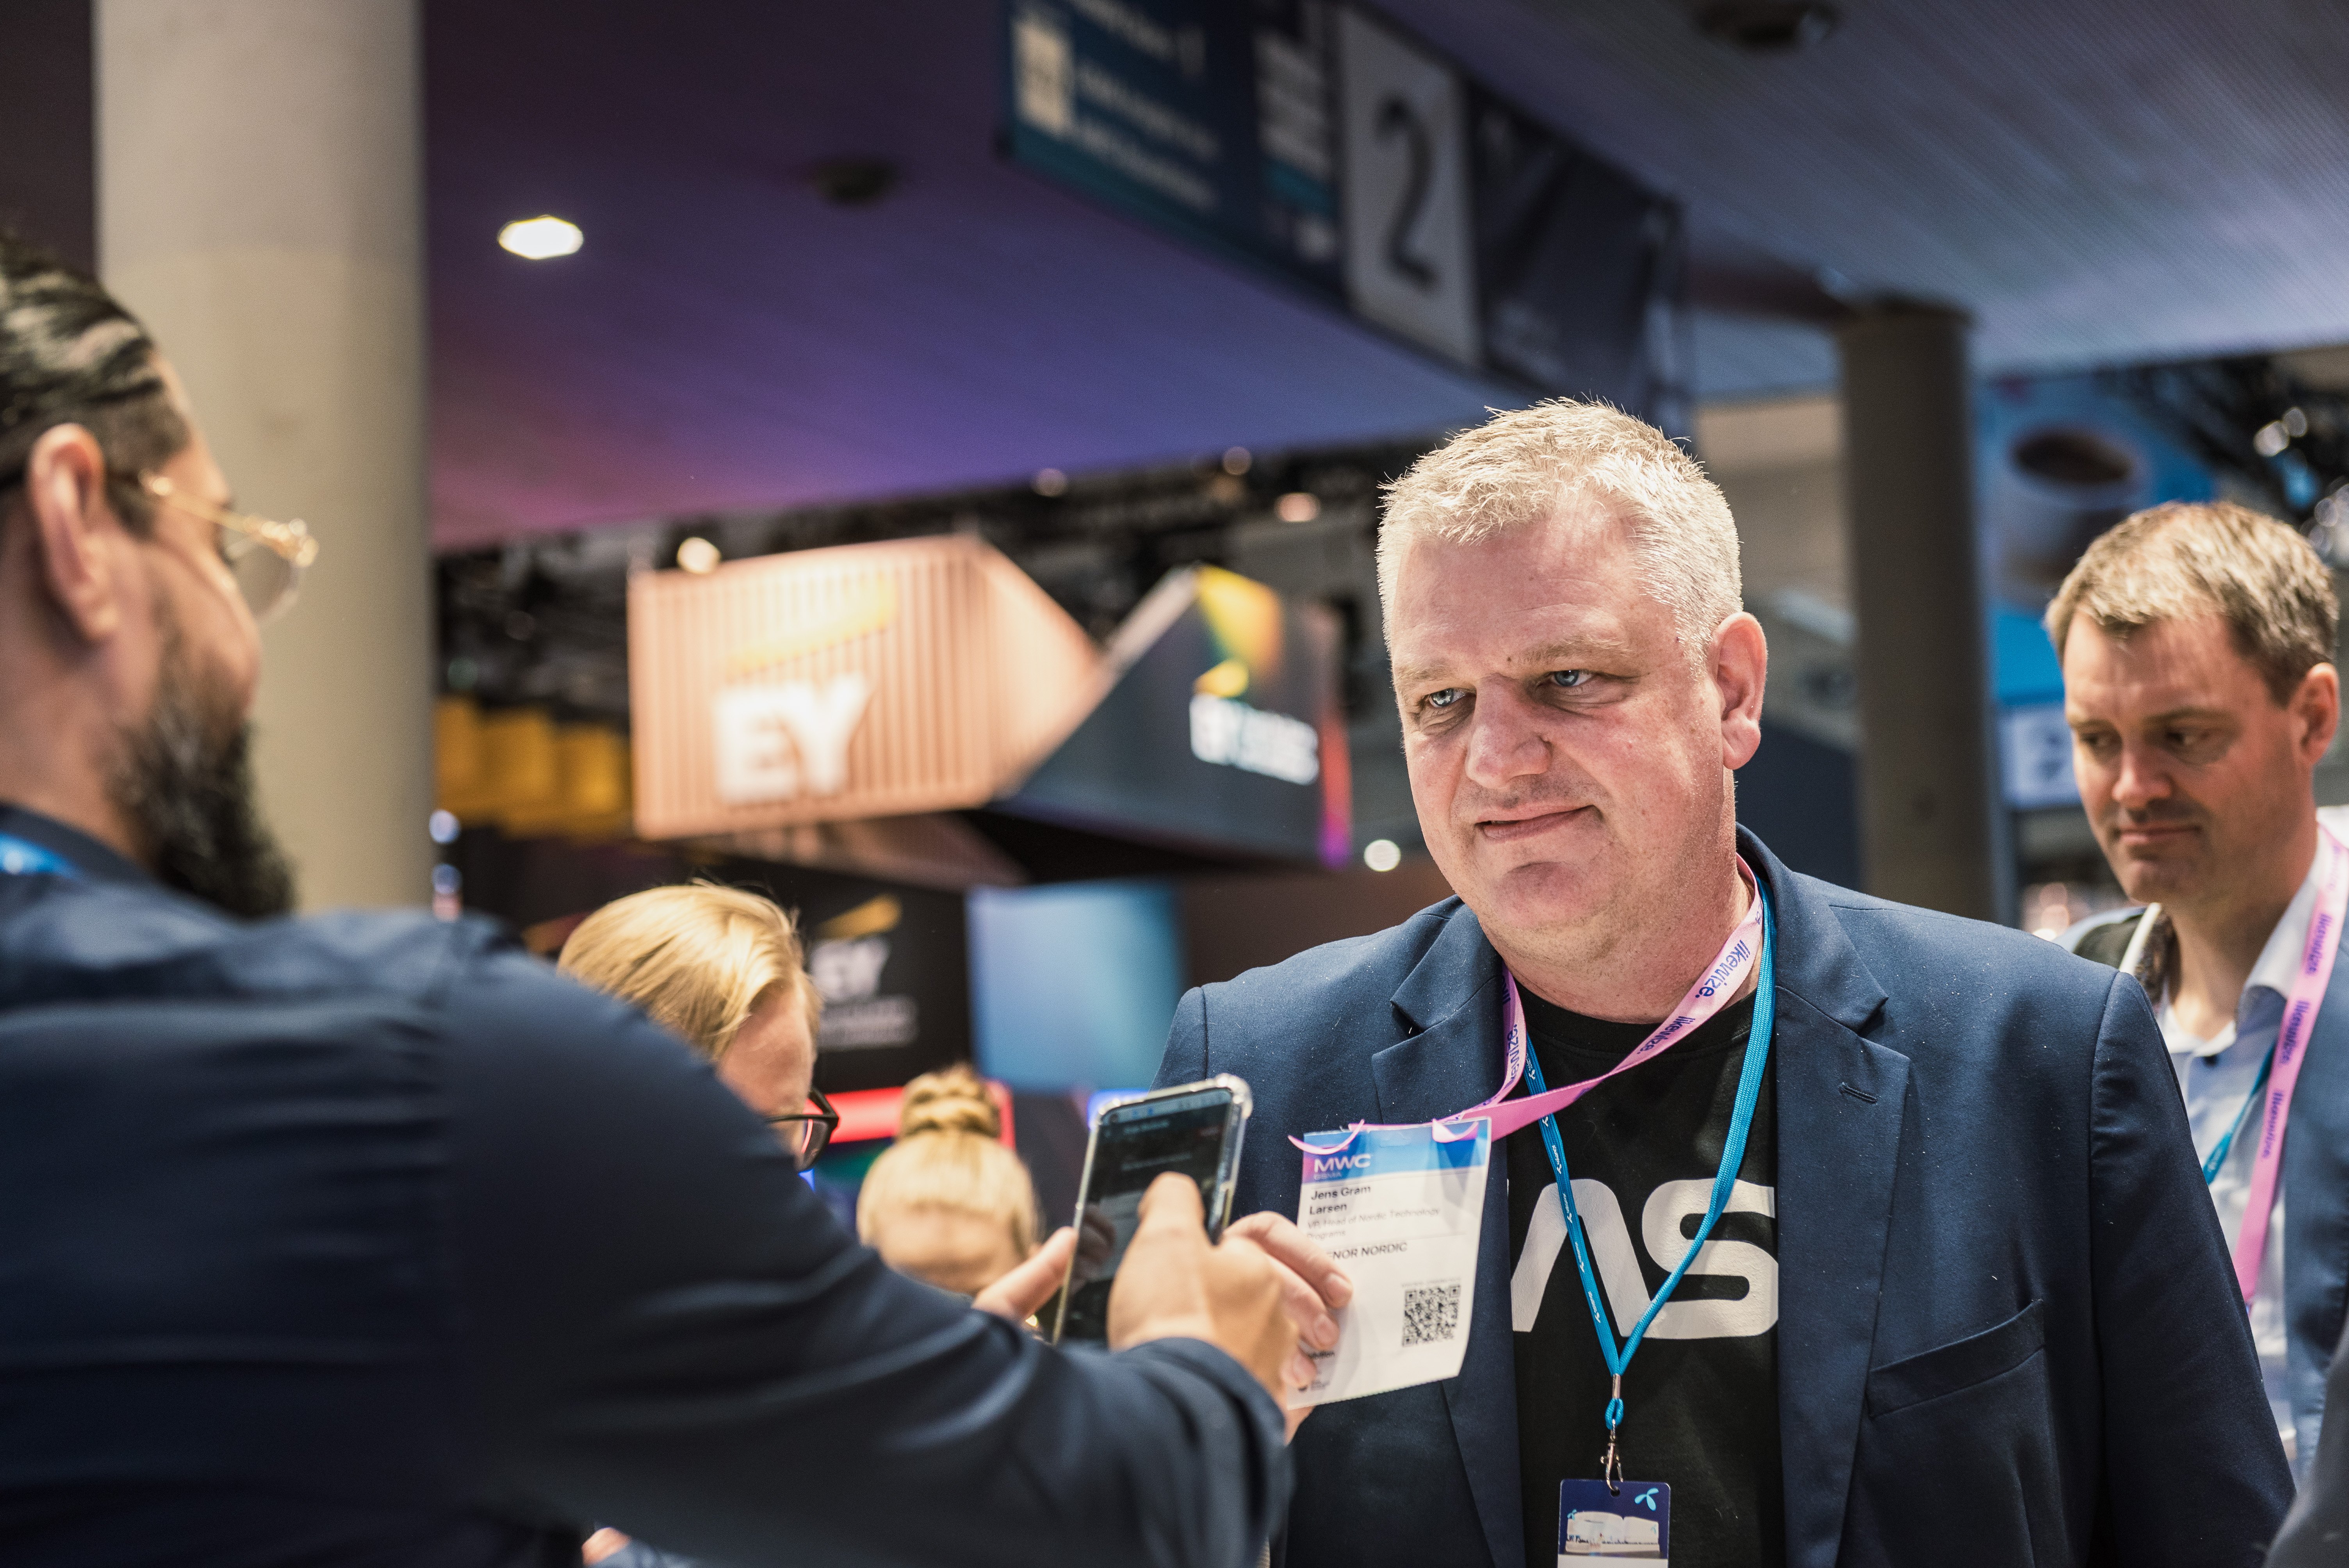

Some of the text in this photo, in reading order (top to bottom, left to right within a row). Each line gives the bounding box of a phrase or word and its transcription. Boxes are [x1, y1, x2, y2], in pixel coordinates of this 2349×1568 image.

[1695, 939, 1751, 998] likewize.
[1314, 1153, 1371, 1172] MWC
[1311, 1186, 1371, 1200] Jens Gram
[1310, 1204, 1347, 1215] Larsen
[1360, 1213, 1387, 1223] Nordic
[1362, 1242, 1407, 1257] NORDIC
